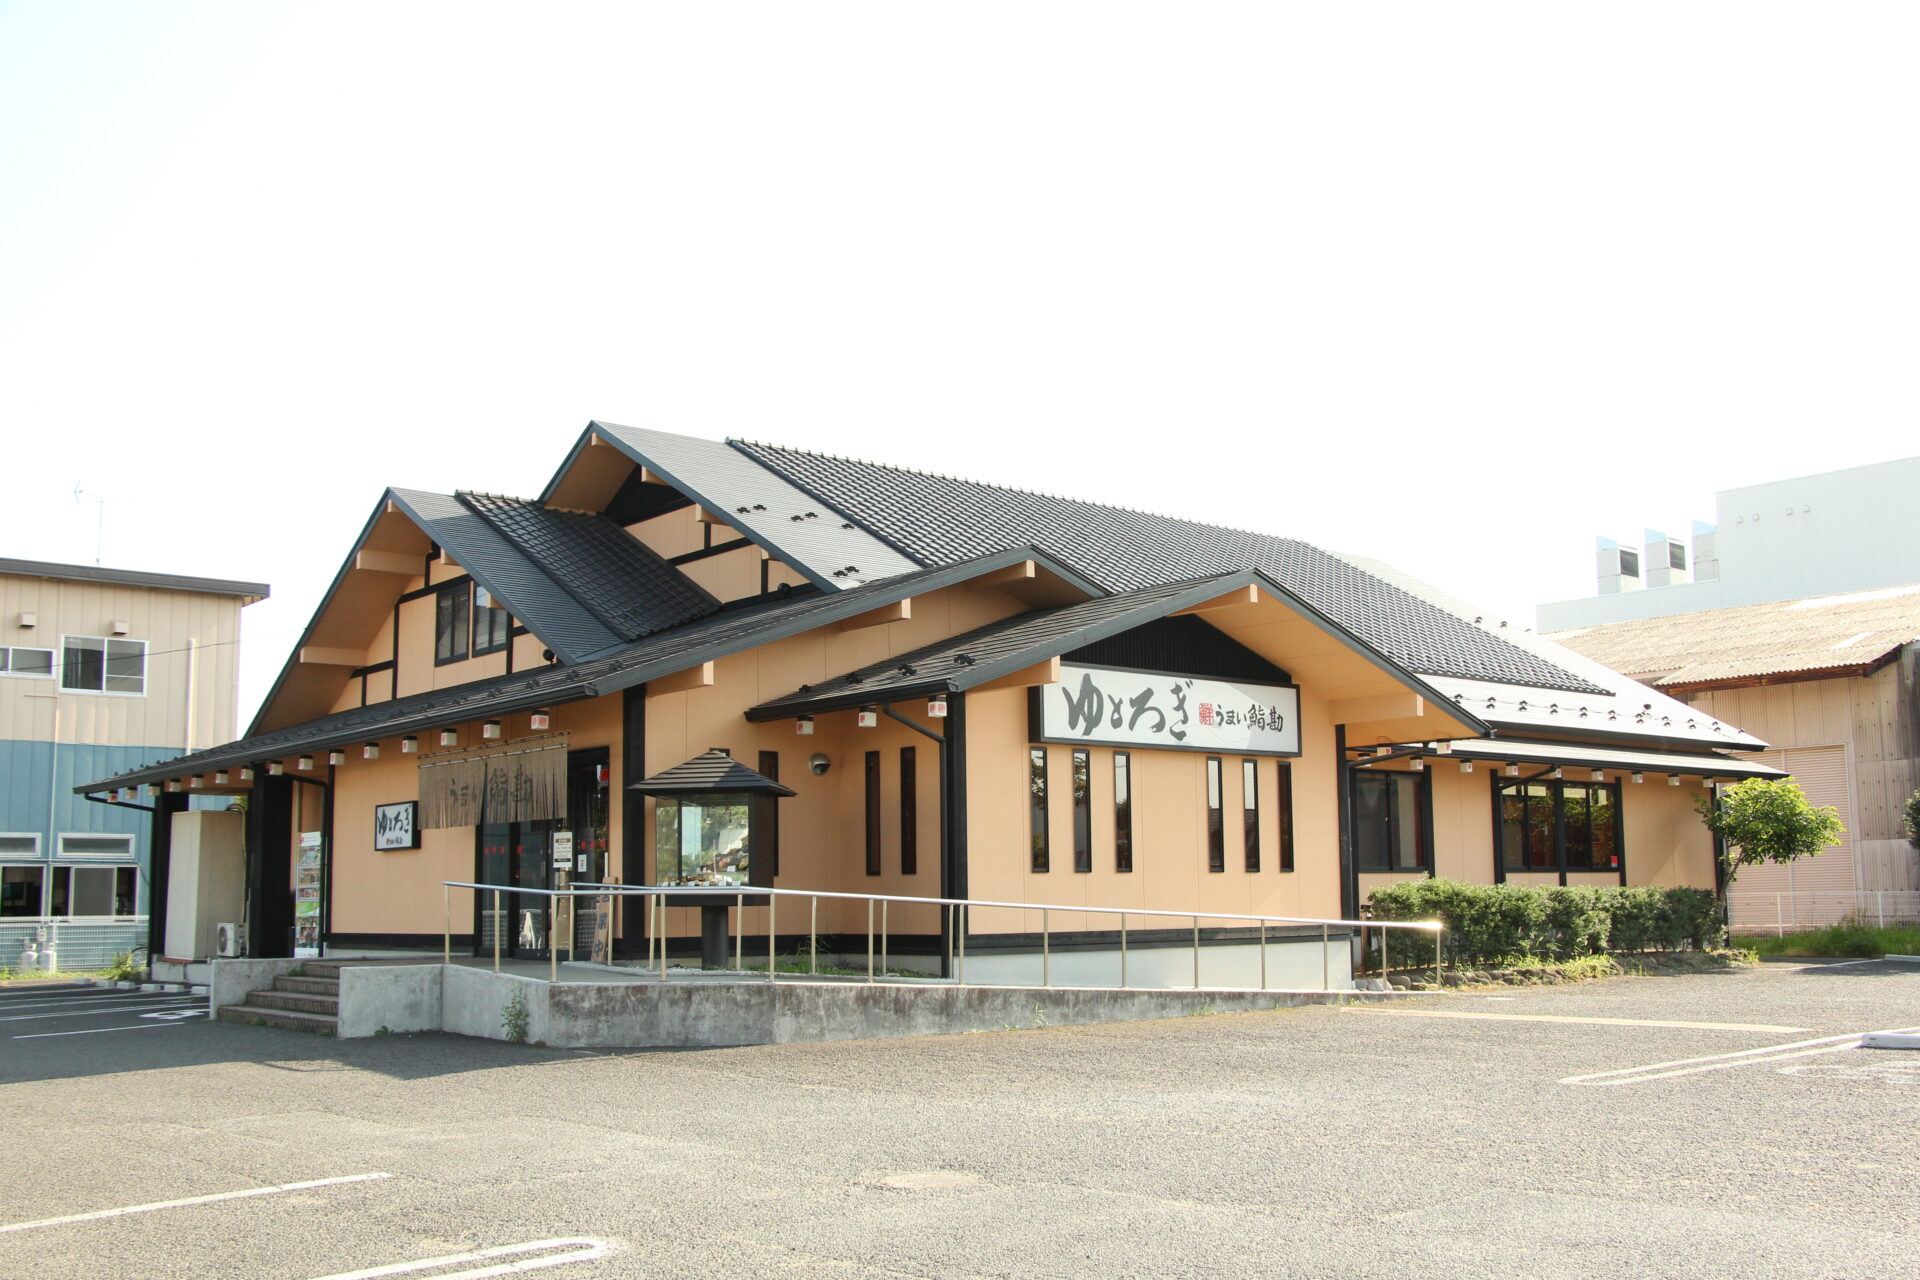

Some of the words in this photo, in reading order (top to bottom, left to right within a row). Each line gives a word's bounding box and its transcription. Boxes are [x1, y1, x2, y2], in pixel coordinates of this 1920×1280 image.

[1061, 672, 1194, 742] ゆとろぎ
[1215, 703, 1284, 732] うまい鮨勘
[377, 804, 412, 837] ゆとろぎ
